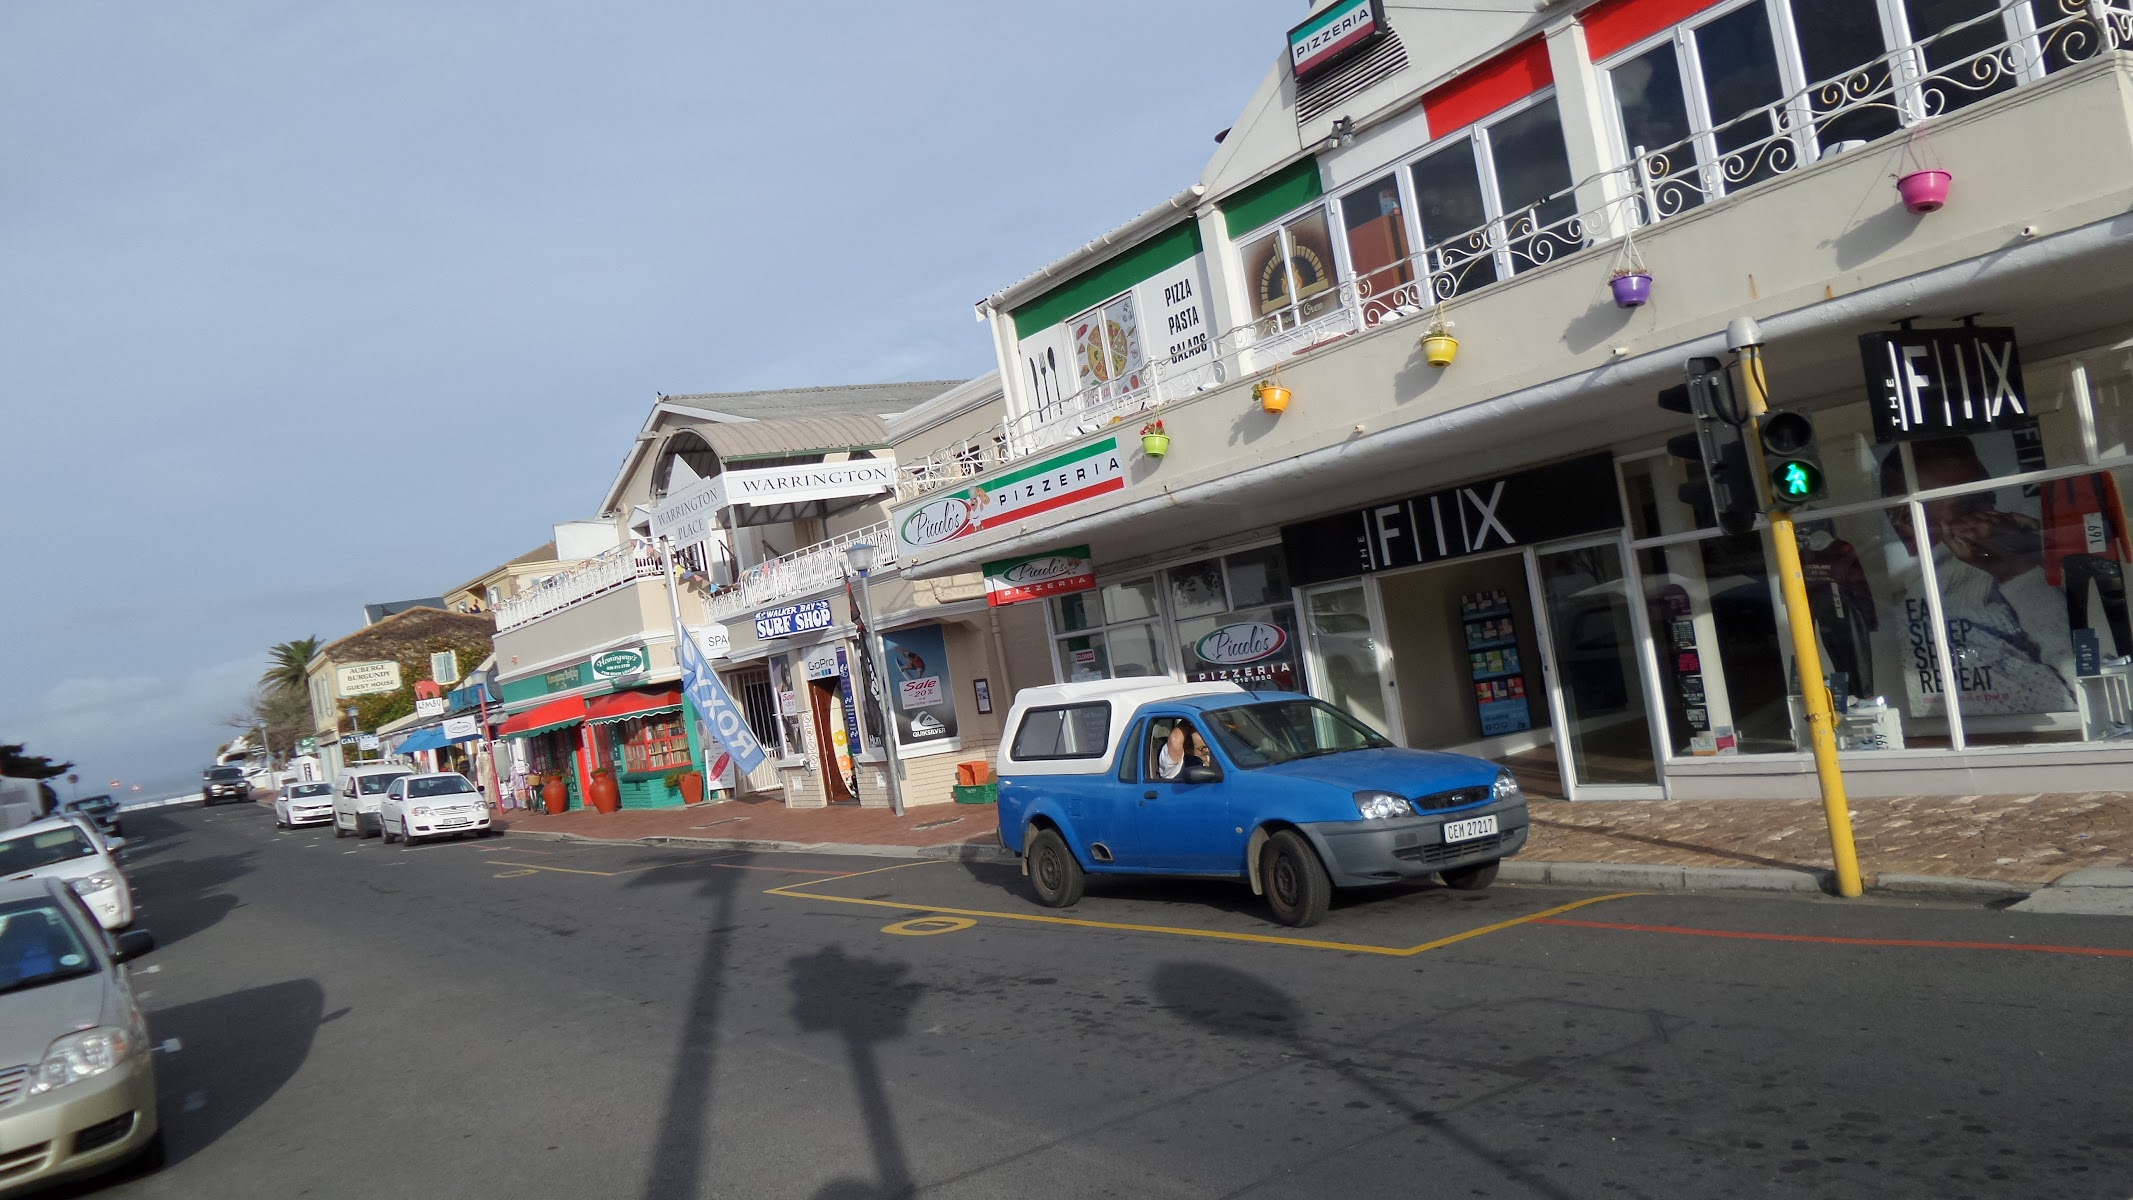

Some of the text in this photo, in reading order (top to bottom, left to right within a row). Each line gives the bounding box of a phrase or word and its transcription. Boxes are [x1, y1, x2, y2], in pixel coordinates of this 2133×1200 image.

[1296, 8, 1369, 58] PIZZERIA
[1164, 278, 1192, 307] PIZZA
[1303, 302, 1323, 316] Oven
[1168, 306, 1200, 336] PASTA
[1170, 332, 1208, 364] SALADS
[1886, 378, 1901, 427] THE
[742, 467, 888, 492] WARRINGTON
[999, 457, 1120, 506] PIZZERIA
[656, 487, 719, 526] WARRINGTON
[677, 518, 704, 540] PLACE
[911, 501, 960, 542] Piccolo's
[2087, 525, 2103, 545] 169
[1357, 536, 1370, 570] THE
[1018, 558, 1065, 581] Piccolo's
[1004, 577, 1086, 597] PIZZERIA
[766, 602, 815, 618] WALKER BAY
[1905, 598, 1931, 623] EA
[757, 608, 831, 638] SURF SHOP
[1909, 618, 1972, 647] SLEP
[708, 635, 728, 647] SPA
[1208, 625, 1269, 660] Piccolo's
[596, 654, 638, 668] Hemingway's
[808, 658, 835, 671] GoPro
[1076, 652, 1093, 660] CLOSED
[347, 671, 391, 682] BURGUNDY
[350, 664, 385, 674] AUBERGE
[1198, 662, 1290, 682] PIZZERIA
[346, 683, 369, 691] GUEST
[371, 679, 395, 688] HOUSE
[903, 679, 937, 692] Sale
[912, 727, 946, 738] QUIKSILVER
[1448, 818, 1493, 839] CEM 27217
